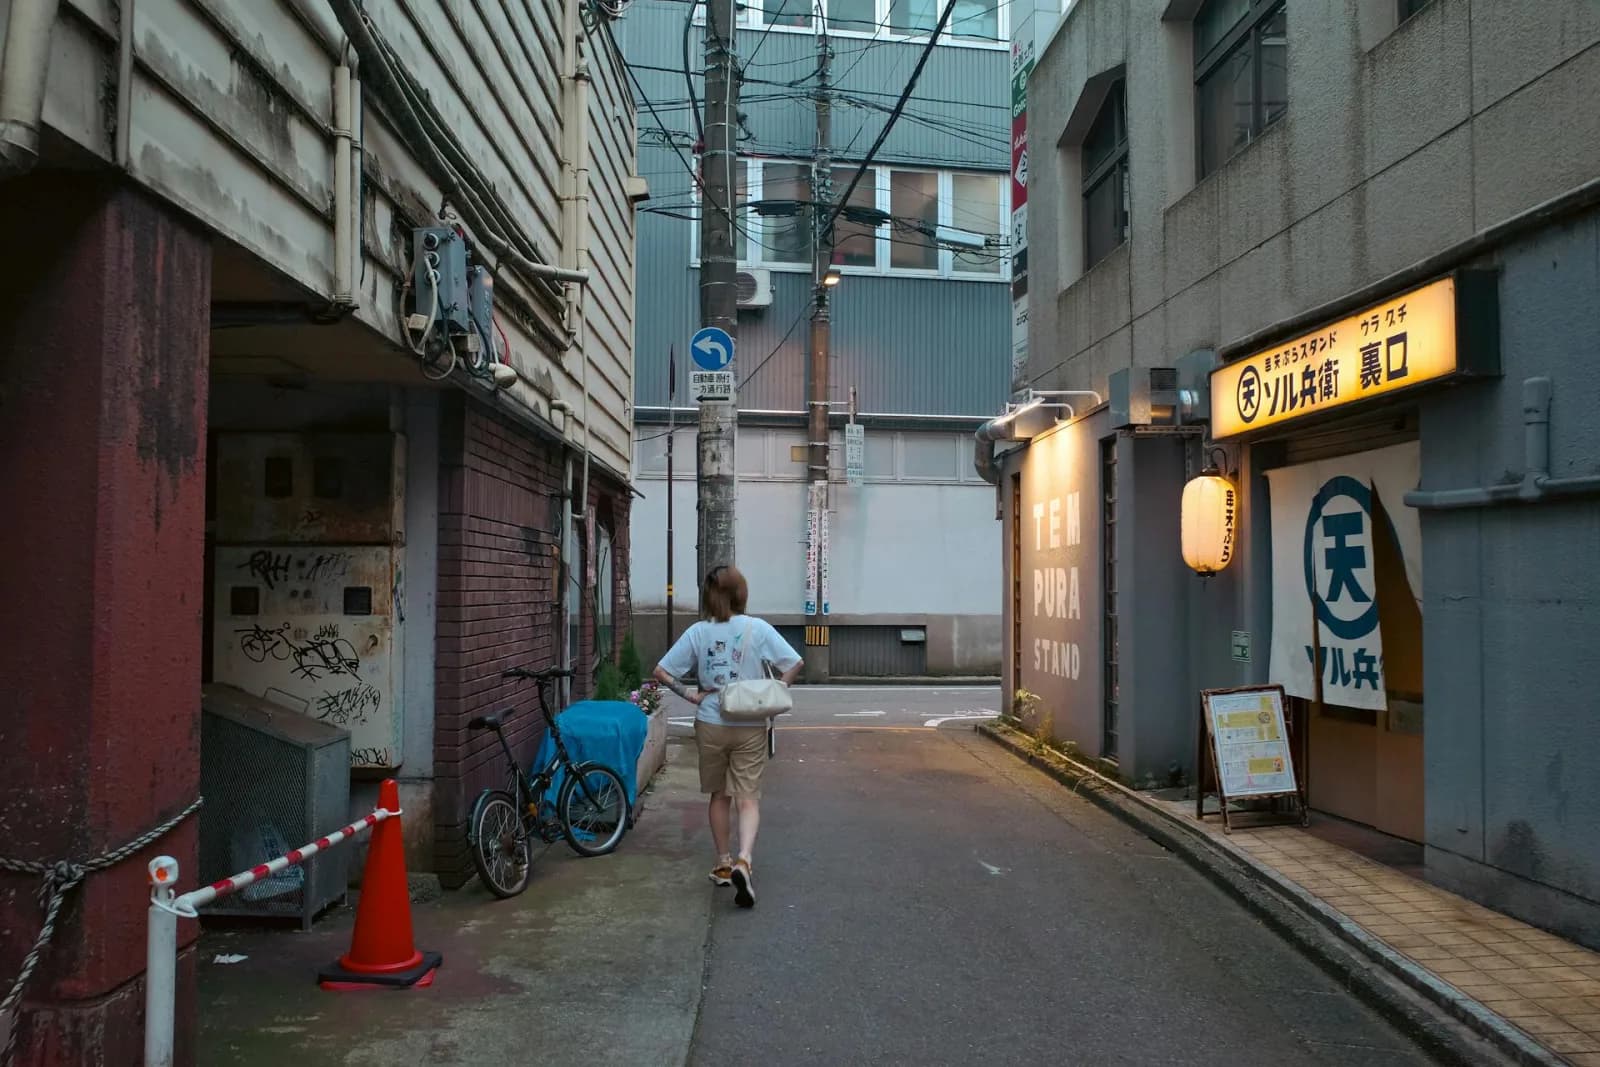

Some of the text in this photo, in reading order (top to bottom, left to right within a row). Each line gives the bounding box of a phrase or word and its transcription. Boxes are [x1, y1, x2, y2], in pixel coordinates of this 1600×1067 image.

[1264, 331, 1409, 417] ソル兵衛 裏口
[1033, 491, 1081, 551] TEM
[1322, 511, 1372, 603] 天
[1033, 567, 1081, 619] PURA
[1034, 638, 1080, 680] STAND
[1304, 645, 1384, 690] ソル兵
